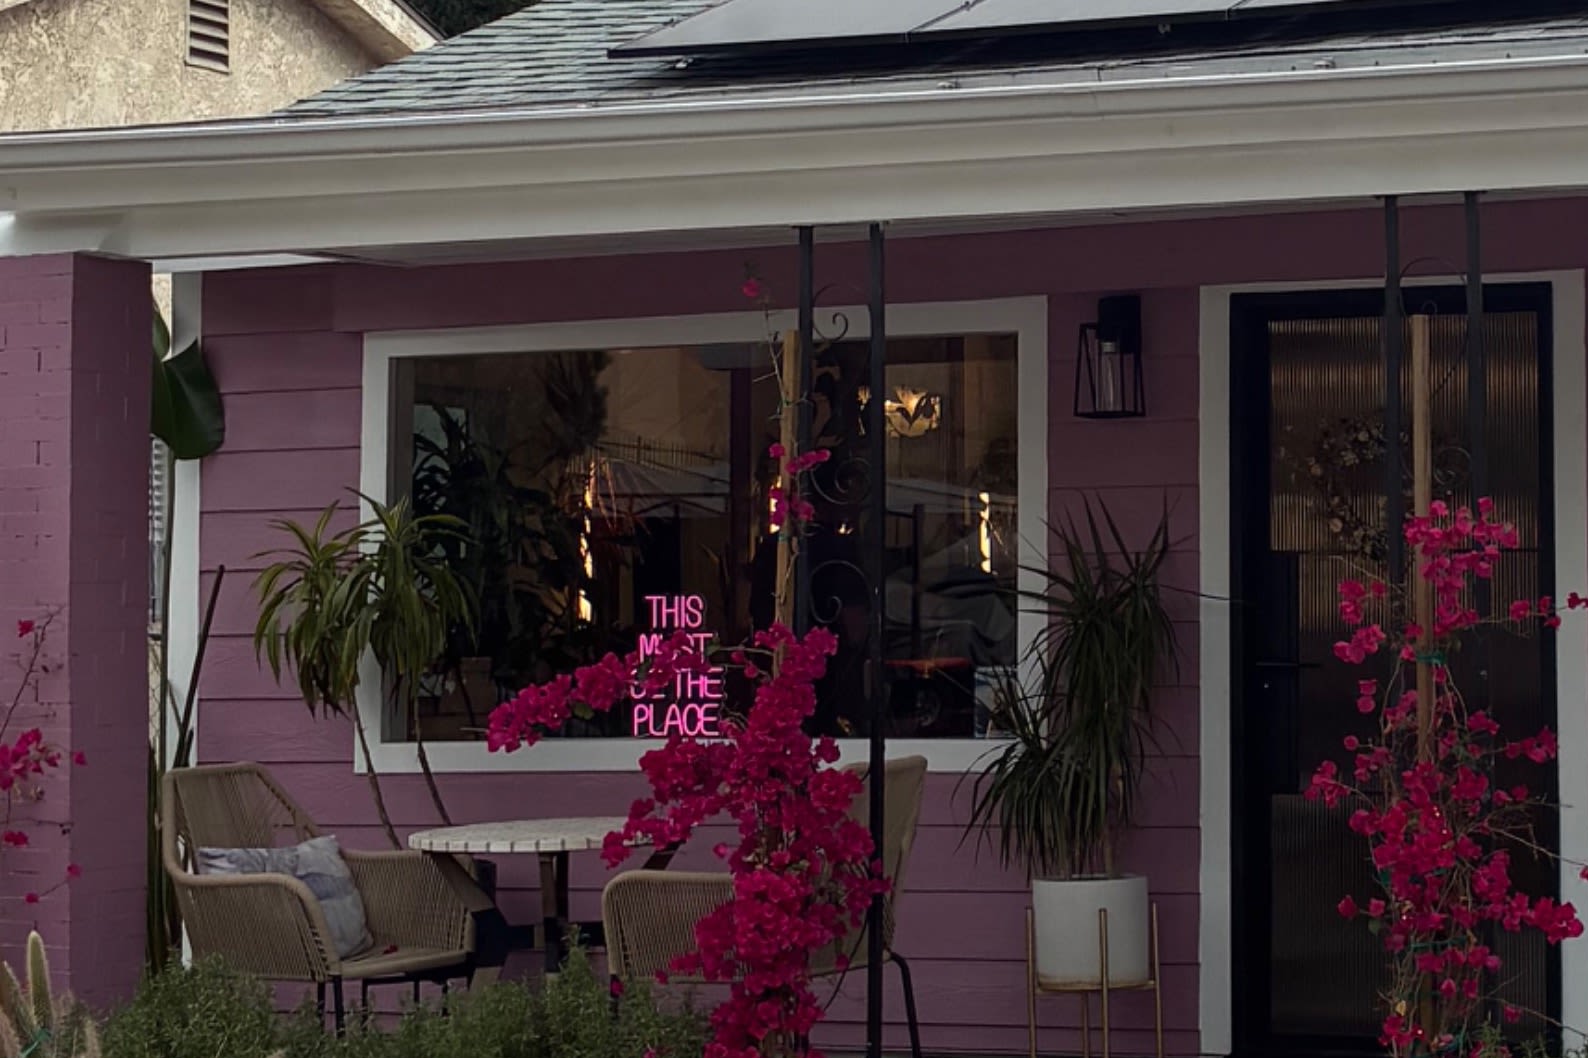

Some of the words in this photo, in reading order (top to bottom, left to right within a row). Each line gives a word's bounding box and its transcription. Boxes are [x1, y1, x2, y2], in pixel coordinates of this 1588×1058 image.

[644, 595, 704, 629] THIS
[674, 666, 724, 700] THE
[633, 703, 721, 737] PLACE
